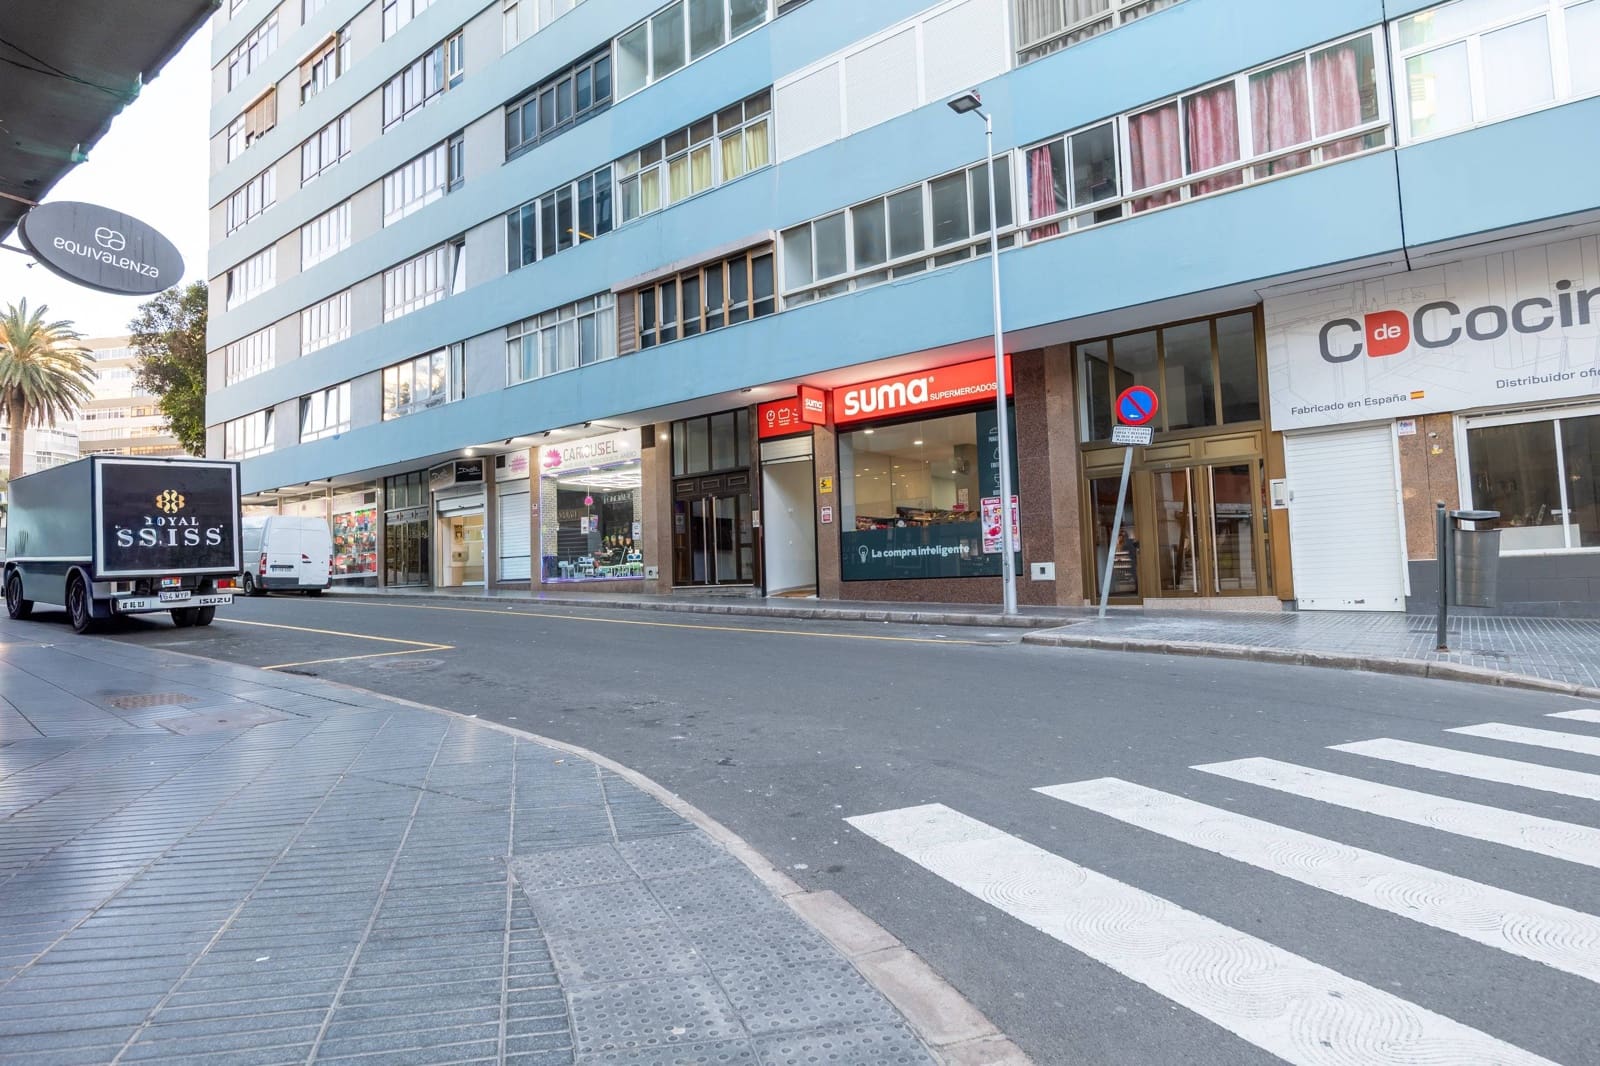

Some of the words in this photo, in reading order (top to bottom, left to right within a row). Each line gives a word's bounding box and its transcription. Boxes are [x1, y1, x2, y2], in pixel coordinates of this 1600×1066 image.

[1373, 322, 1401, 341] de
[1495, 371, 1576, 389] Distribuidor
[844, 377, 928, 416] suma
[929, 382, 998, 401] SUPERMERCADOS
[1291, 401, 1344, 416] Fabricado
[1347, 399, 1361, 409] en
[1364, 393, 1407, 407] España
[871, 548, 882, 558] La
[883, 547, 917, 559] compra
[918, 543, 970, 556] inteligente
